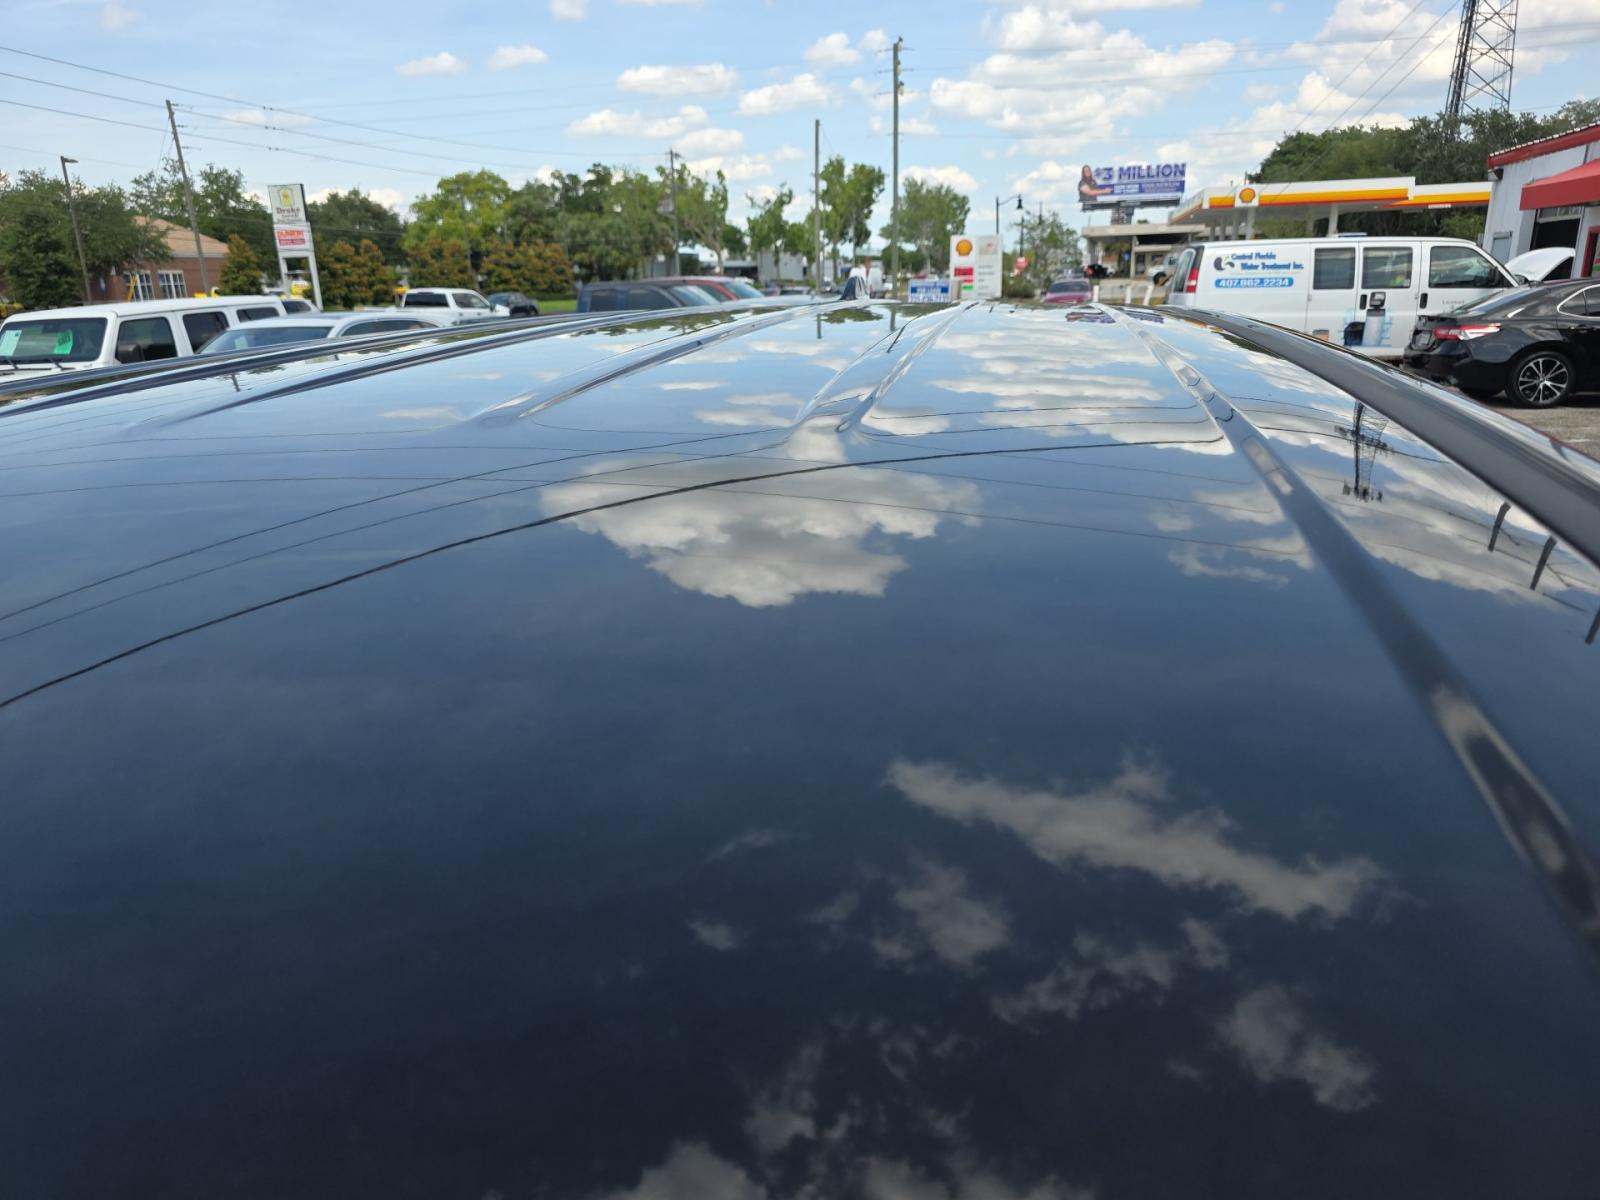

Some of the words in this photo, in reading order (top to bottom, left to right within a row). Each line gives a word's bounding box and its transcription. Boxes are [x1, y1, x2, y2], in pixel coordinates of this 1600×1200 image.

[1118, 163, 1186, 180] MILLION
[1255, 252, 1276, 260] Florida
[1241, 262, 1259, 270] Water
[1261, 262, 1291, 270] Treatment
